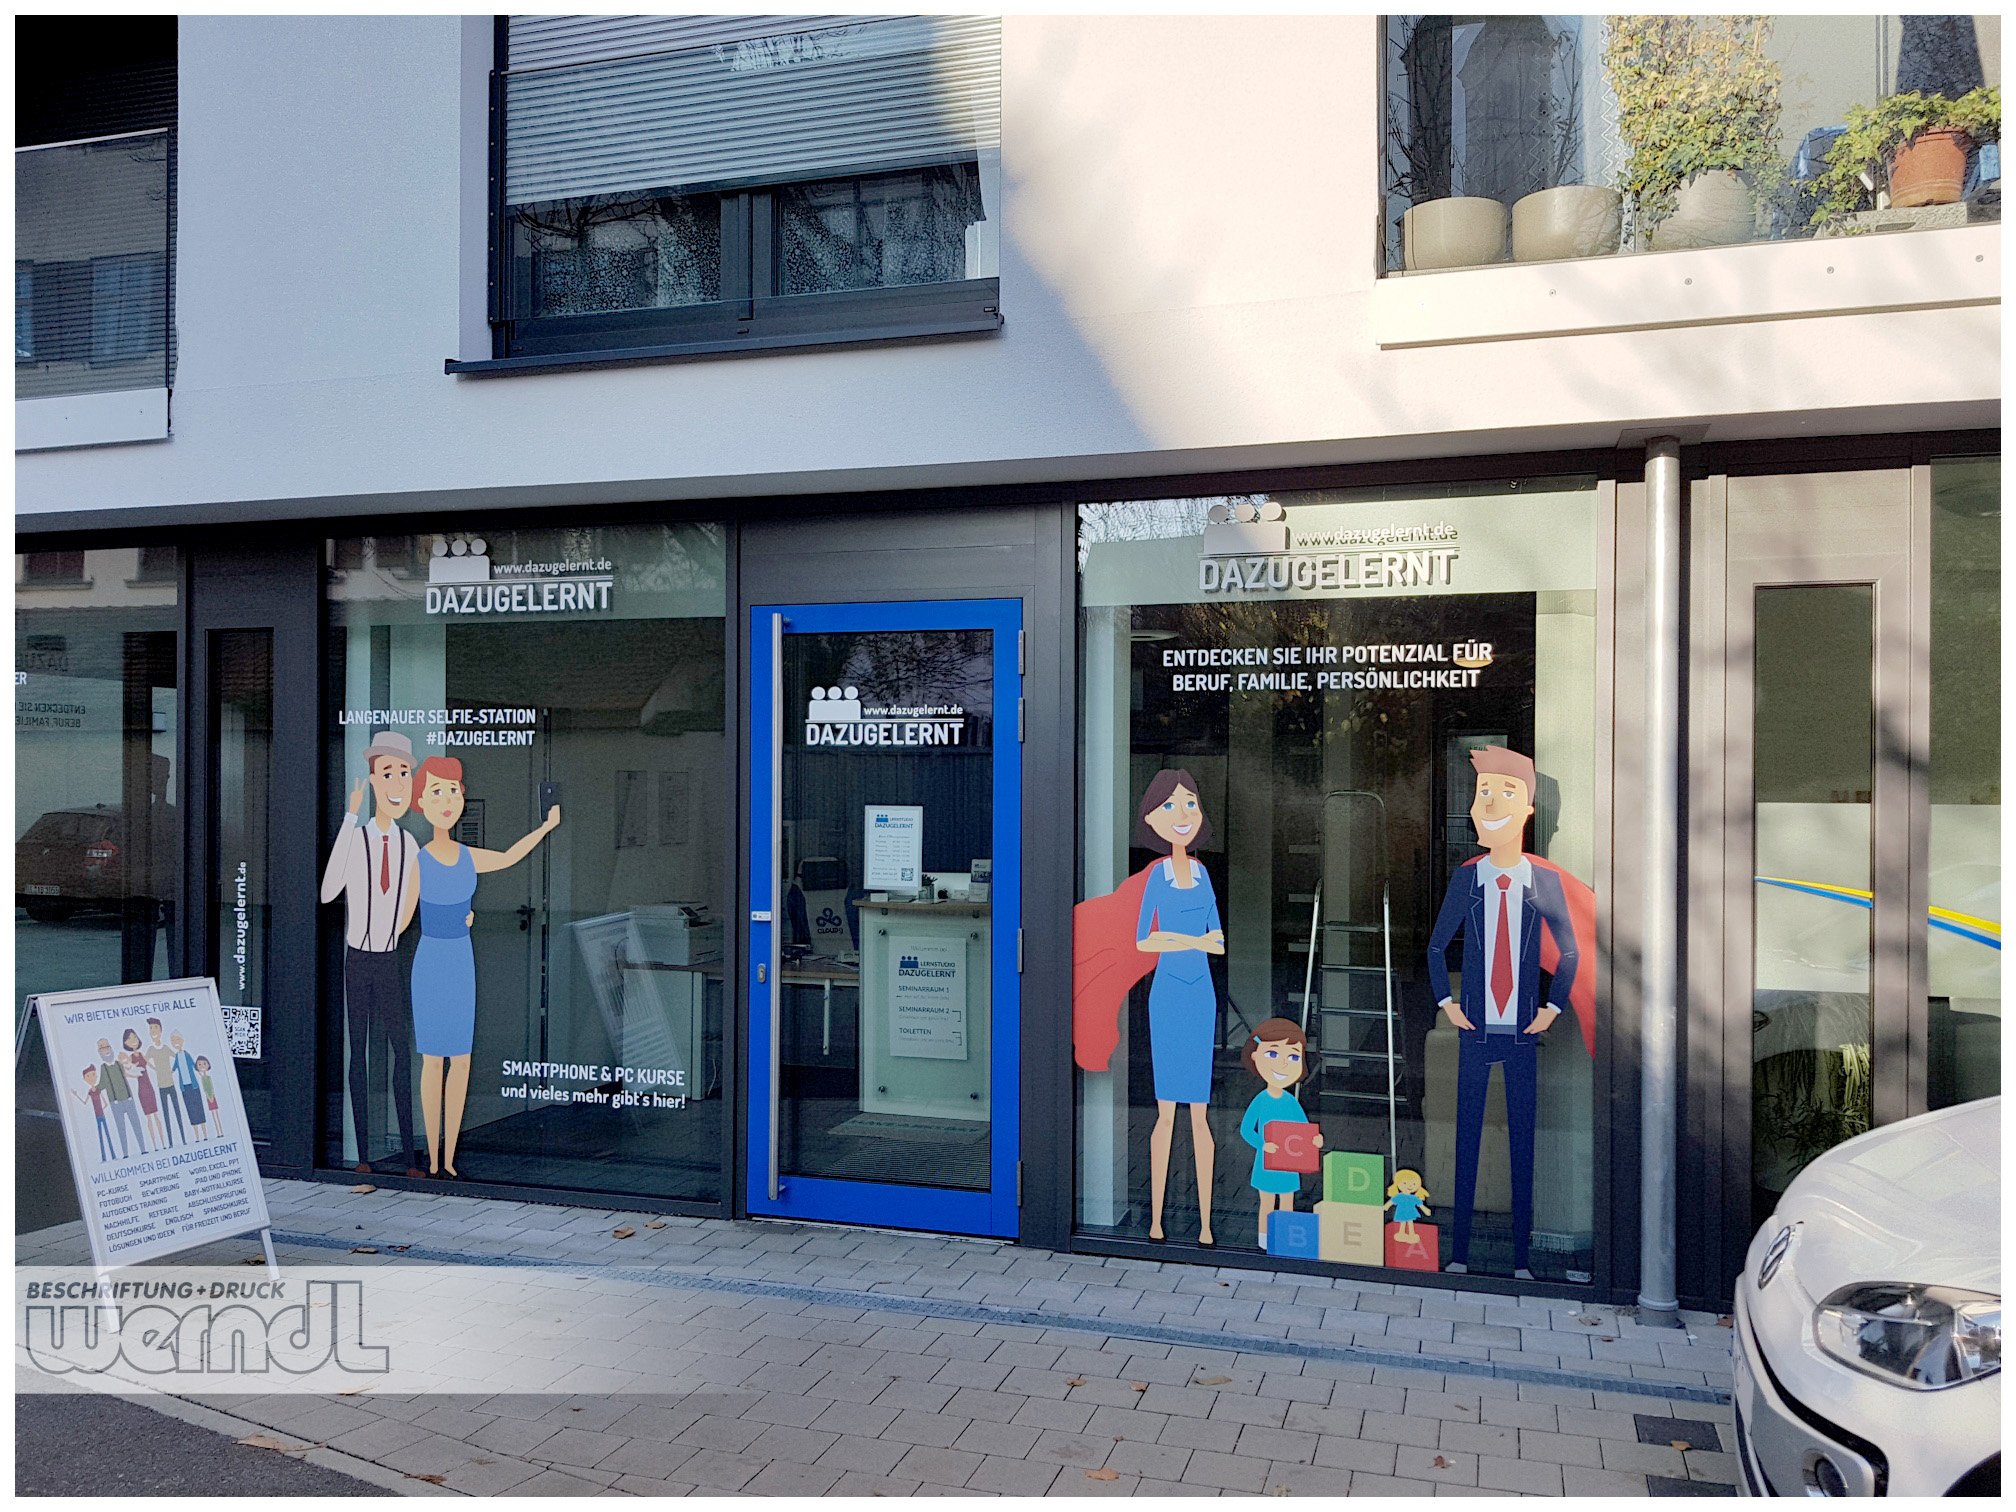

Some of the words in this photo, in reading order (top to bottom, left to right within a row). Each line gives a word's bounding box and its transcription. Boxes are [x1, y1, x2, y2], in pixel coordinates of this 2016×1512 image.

[1293, 521, 1454, 542] www.dazugelernt.de
[493, 557, 612, 575] www.dazugelernt.de
[1199, 550, 1458, 590] DAZUGELERNT
[425, 581, 613, 614] DAZUGELERNT
[1163, 648, 1268, 667] ENTDECKEN
[1272, 647, 1301, 665] SIE
[1306, 647, 1337, 664] IHR
[1342, 644, 1448, 663] POTENZIAL
[1453, 639, 1493, 661] FÜR
[1172, 674, 1233, 693] BERUF,
[1238, 673, 1312, 692] FAMILIE,
[1317, 667, 1480, 690] PERSÖNLICHKEIT
[338, 709, 425, 725] LANGENAUER
[428, 708, 536, 725] SELFIE-STATION
[864, 703, 963, 717] www.dazugelernt.de
[425, 730, 536, 746] #DAZUGELERNT
[806, 723, 964, 746] DAZUGELERNT
[233, 861, 249, 991] www.dazugelernt.de
[898, 969, 956, 978] DAZUGELERNT
[898, 985, 945, 993] SEMINARRAUM
[64, 1013, 85, 1024] WIR
[86, 1008, 120, 1022] BIETEN
[121, 1004, 152, 1017] KURSE
[152, 1000, 171, 1013] FÜR
[172, 997, 197, 1010] ALLE
[898, 1005, 944, 1014] SEMINARRAUM
[899, 1027, 932, 1035] TOILETTEN
[502, 1060, 598, 1081] SMARTPHONE
[600, 1066, 612, 1082] &
[615, 1067, 634, 1083] PC
[637, 1068, 685, 1086] KURSE
[501, 1083, 527, 1099] und
[529, 1085, 569, 1102] vieles
[572, 1088, 610, 1104] mehr
[612, 1090, 650, 1109] gibt's
[653, 1093, 686, 1109] hier!
[1284, 1134, 1304, 1157] C
[91, 1162, 155, 1185] WILLKOMMEN
[156, 1158, 171, 1170] BEI
[172, 1142, 238, 1166] DAZUGELERNT
[97, 1184, 129, 1198] PC-KURSE
[139, 1172, 181, 1188] SMARTPHONE
[99, 1194, 133, 1209] FOTOBUCH
[141, 1182, 180, 1198] BEWERBUNG
[208, 1172, 221, 1181] UND
[1348, 1166, 1371, 1192] D
[102, 1203, 139, 1219] AUTOGENES
[139, 1196, 168, 1209] TRAINING
[183, 1177, 245, 1198] BABY-NOTFALLKURSE
[104, 1215, 140, 1230] NACHHILFE
[148, 1205, 180, 1219] REFERATE
[106, 1222, 157, 1242] DEUTSCHKURSE
[165, 1212, 194, 1226] ENGLISCH
[203, 1197, 249, 1215] SPANISCHKURSE
[108, 1236, 143, 1253] LÖSUNGEN
[142, 1234, 157, 1243] UND
[157, 1228, 176, 1240] IDEEN
[219, 1213, 233, 1222] UND
[233, 1207, 252, 1218] BERUF
[1288, 1225, 1307, 1247] B
[1343, 1221, 1362, 1246] E
[1404, 1241, 1430, 1260] A
